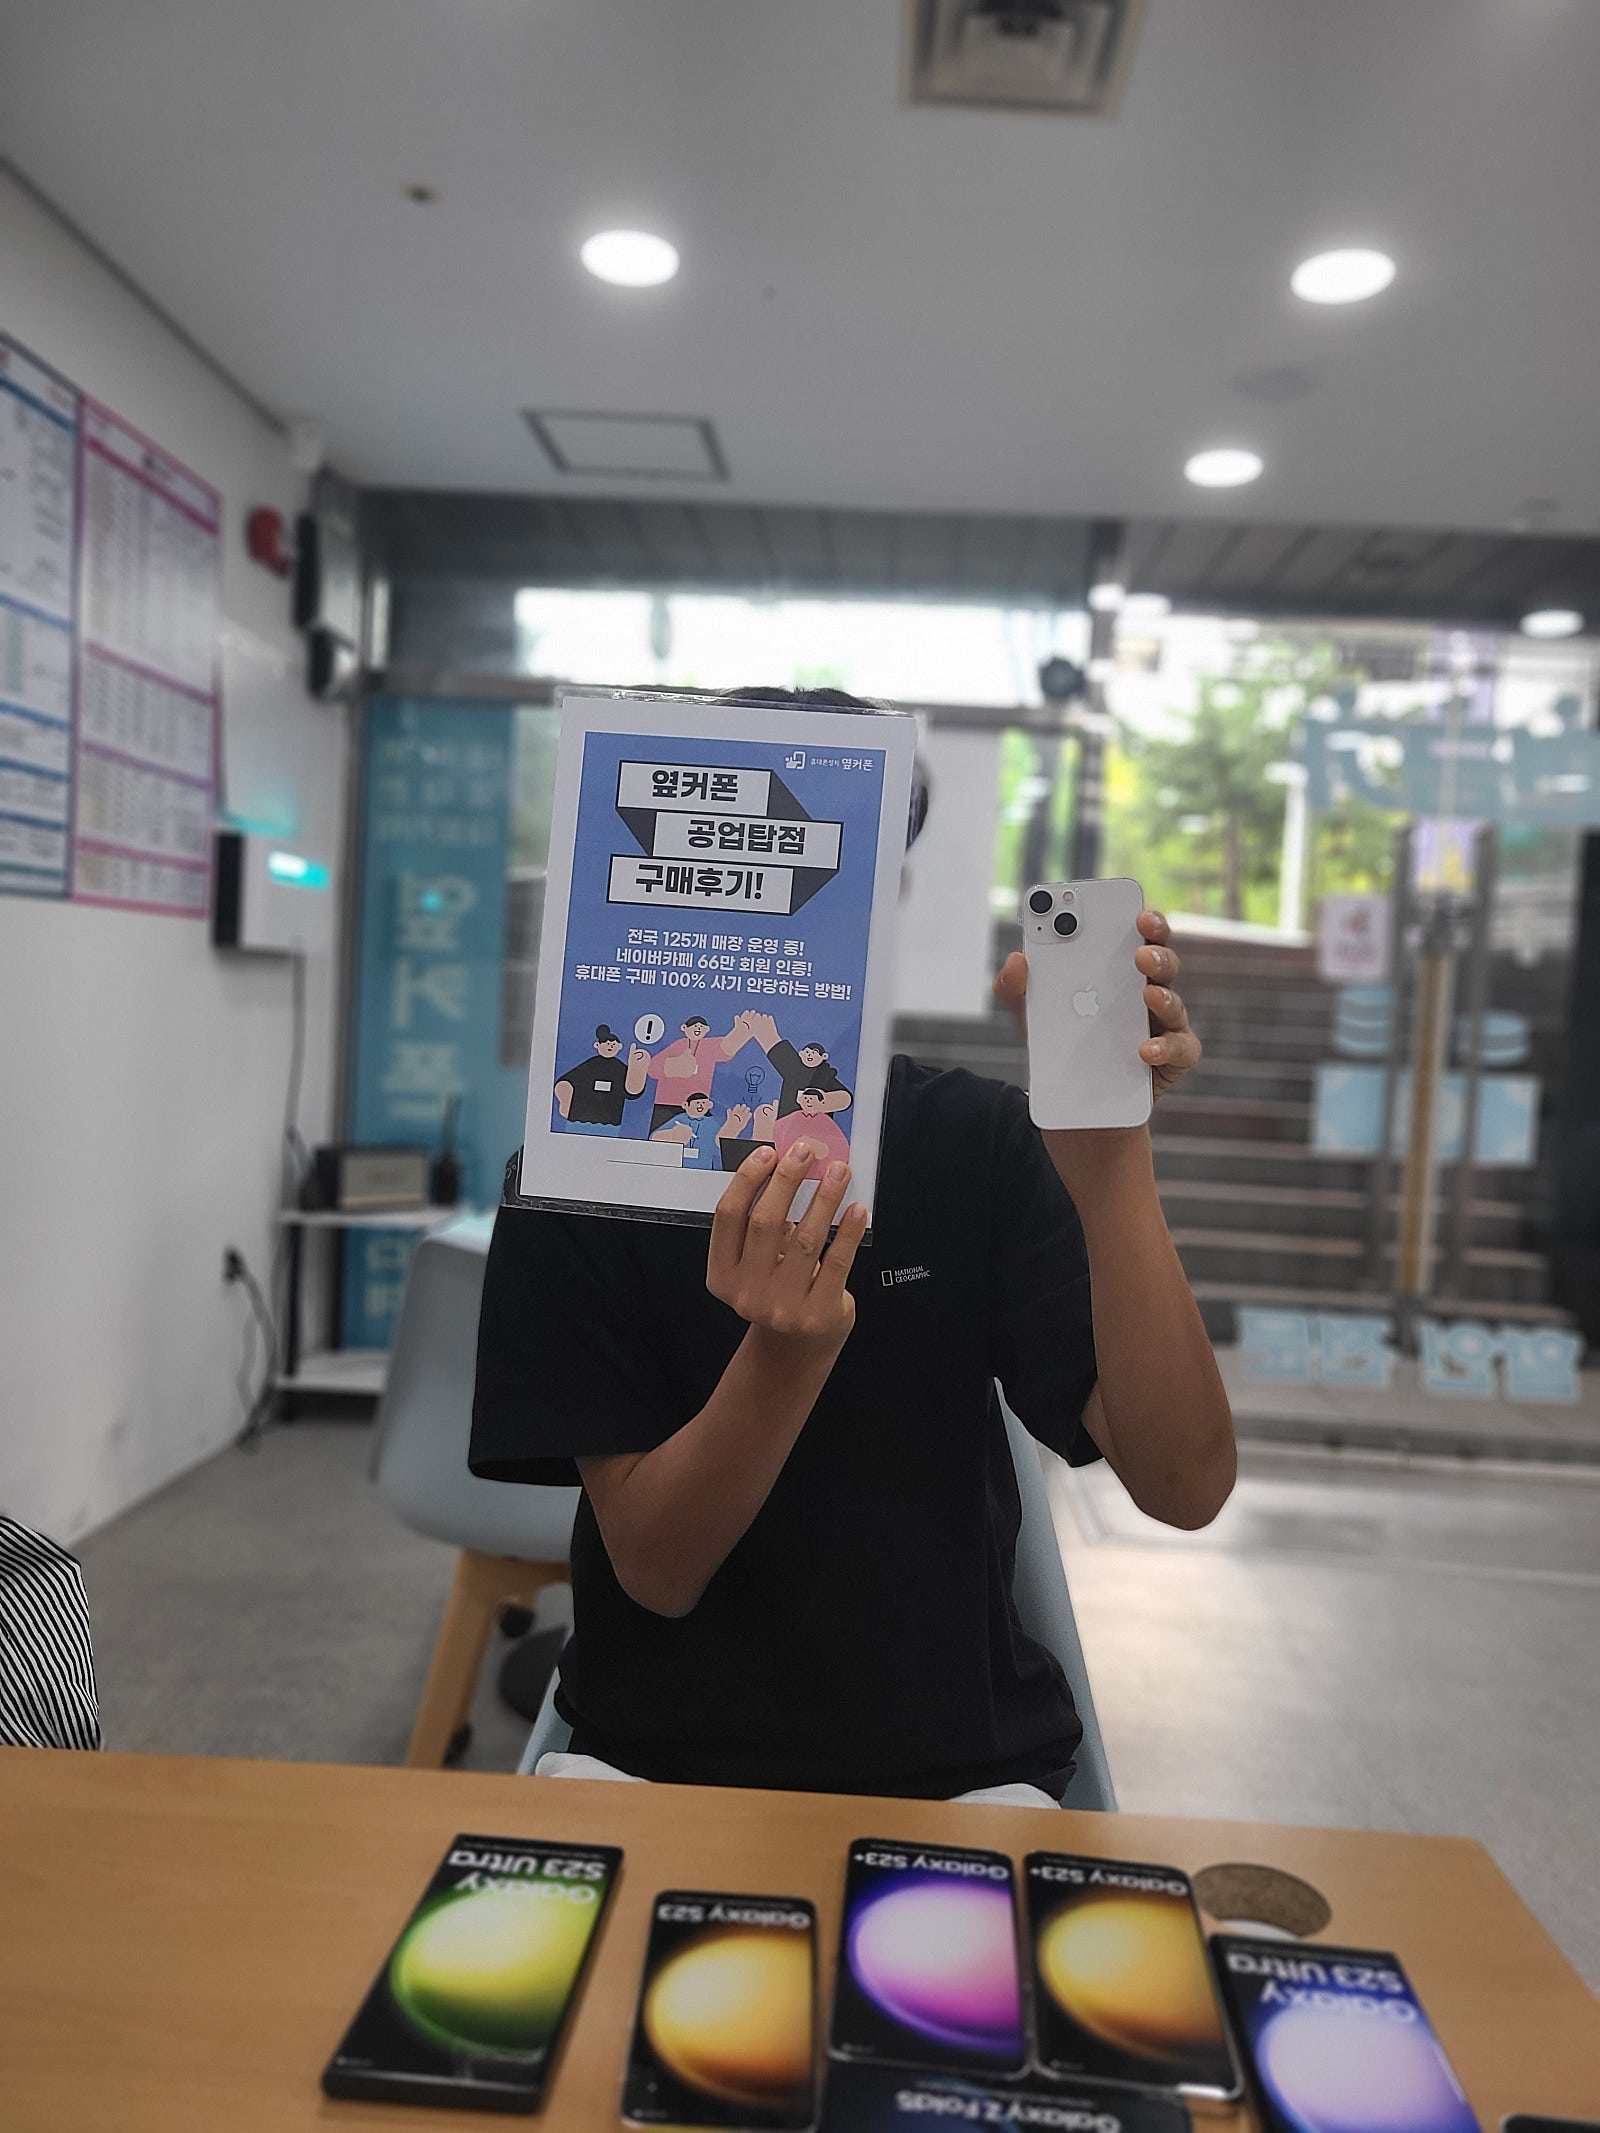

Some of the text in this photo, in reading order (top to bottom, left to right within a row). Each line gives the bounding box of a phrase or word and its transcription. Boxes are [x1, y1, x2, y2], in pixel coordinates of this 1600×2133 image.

[841, 757, 874, 772] 옆커폰
[651, 769, 739, 802] 옆커폰
[687, 819, 807, 855] 공업탑점
[635, 863, 764, 900] 구매후기!
[627, 928, 805, 957] 전국 125개 매장 운영 중!
[616, 948, 813, 977] 네이버카페 66만 회원 인증!
[574, 964, 852, 1001] 휴대폰 구매 100% 사기 안당하는 방법!
[448, 1849, 606, 1881] S23 Ultra
[854, 1851, 1010, 1880] Galaxy S23+
[1029, 1864, 1189, 1896] Galaxy S23+
[454, 1871, 597, 1904] Galaxy
[657, 1903, 811, 1930] Galaxy S23
[1225, 1952, 1404, 1994] S23 Ultra
[1259, 1979, 1418, 2024] Galaxy
[1004, 2099, 1121, 2133] Galaxy
